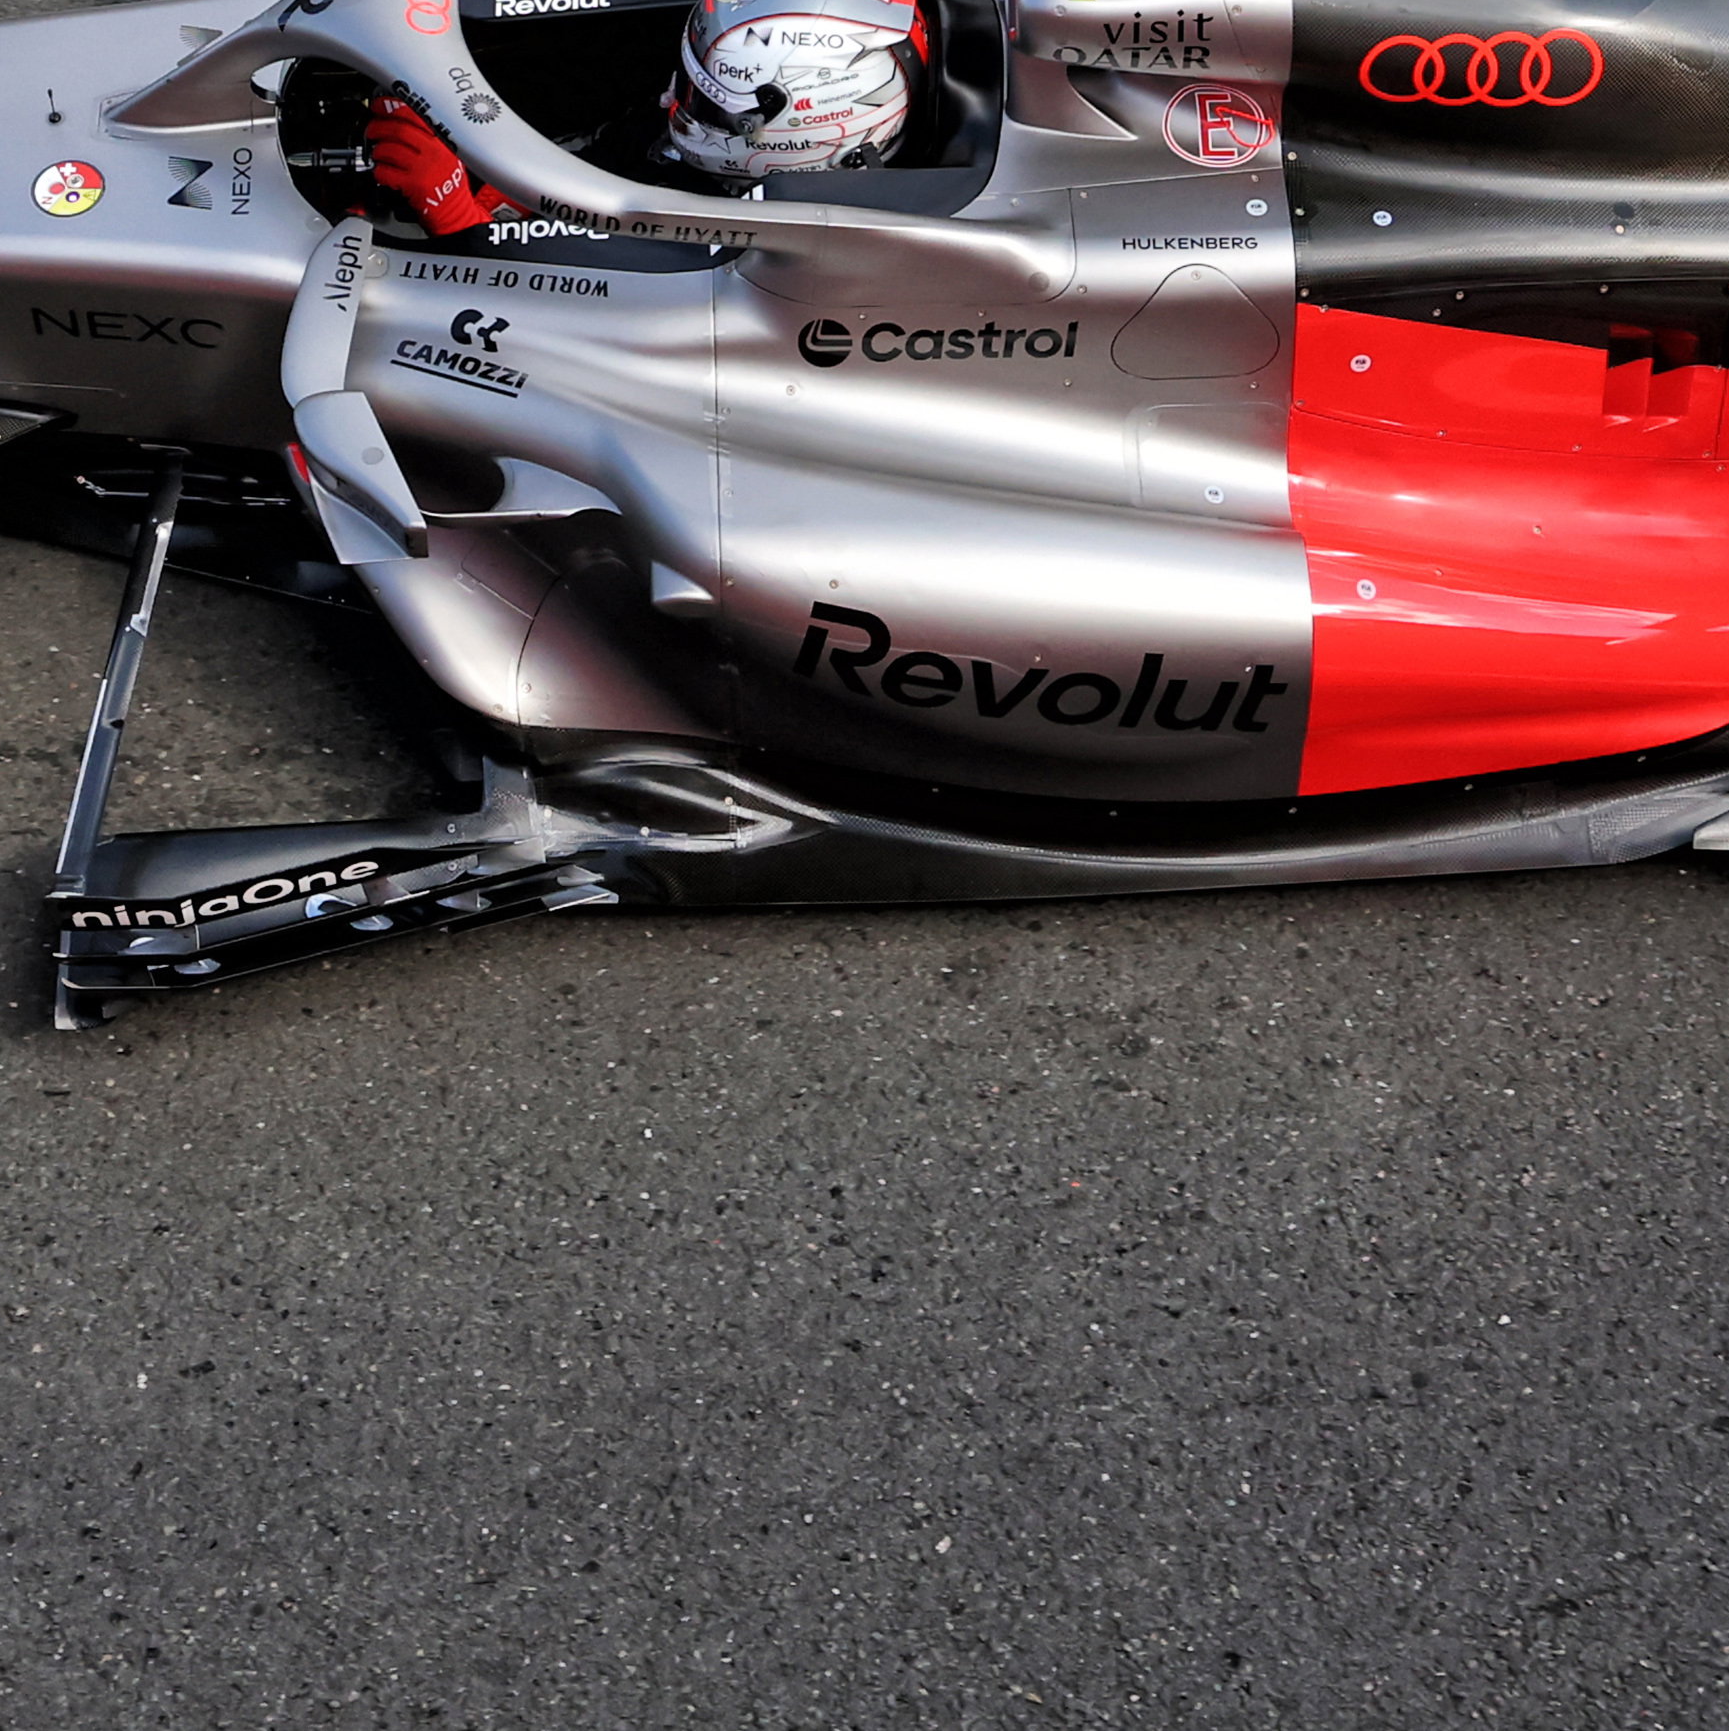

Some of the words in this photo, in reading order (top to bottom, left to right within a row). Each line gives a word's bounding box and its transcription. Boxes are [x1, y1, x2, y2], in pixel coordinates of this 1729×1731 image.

[1103, 9, 1214, 45] visit
[781, 31, 845, 49] NEXO
[1053, 46, 1211, 69] QATAR
[817, 89, 862, 106] Heinemann
[802, 107, 854, 125] Castrol
[231, 147, 253, 215] NEXO
[539, 195, 621, 232] WORLD
[631, 221, 665, 238] OF
[675, 226, 758, 246] HYATT
[1121, 237, 1258, 253] HULKENBERG
[399, 260, 480, 285] HYATT
[488, 271, 520, 288] OF
[529, 275, 610, 298] WORLD
[861, 320, 1079, 364] Castrol
[396, 339, 529, 389] CAMOZZI
[791, 600, 1288, 733] Revolut
[72, 859, 379, 929] ninjaOne
